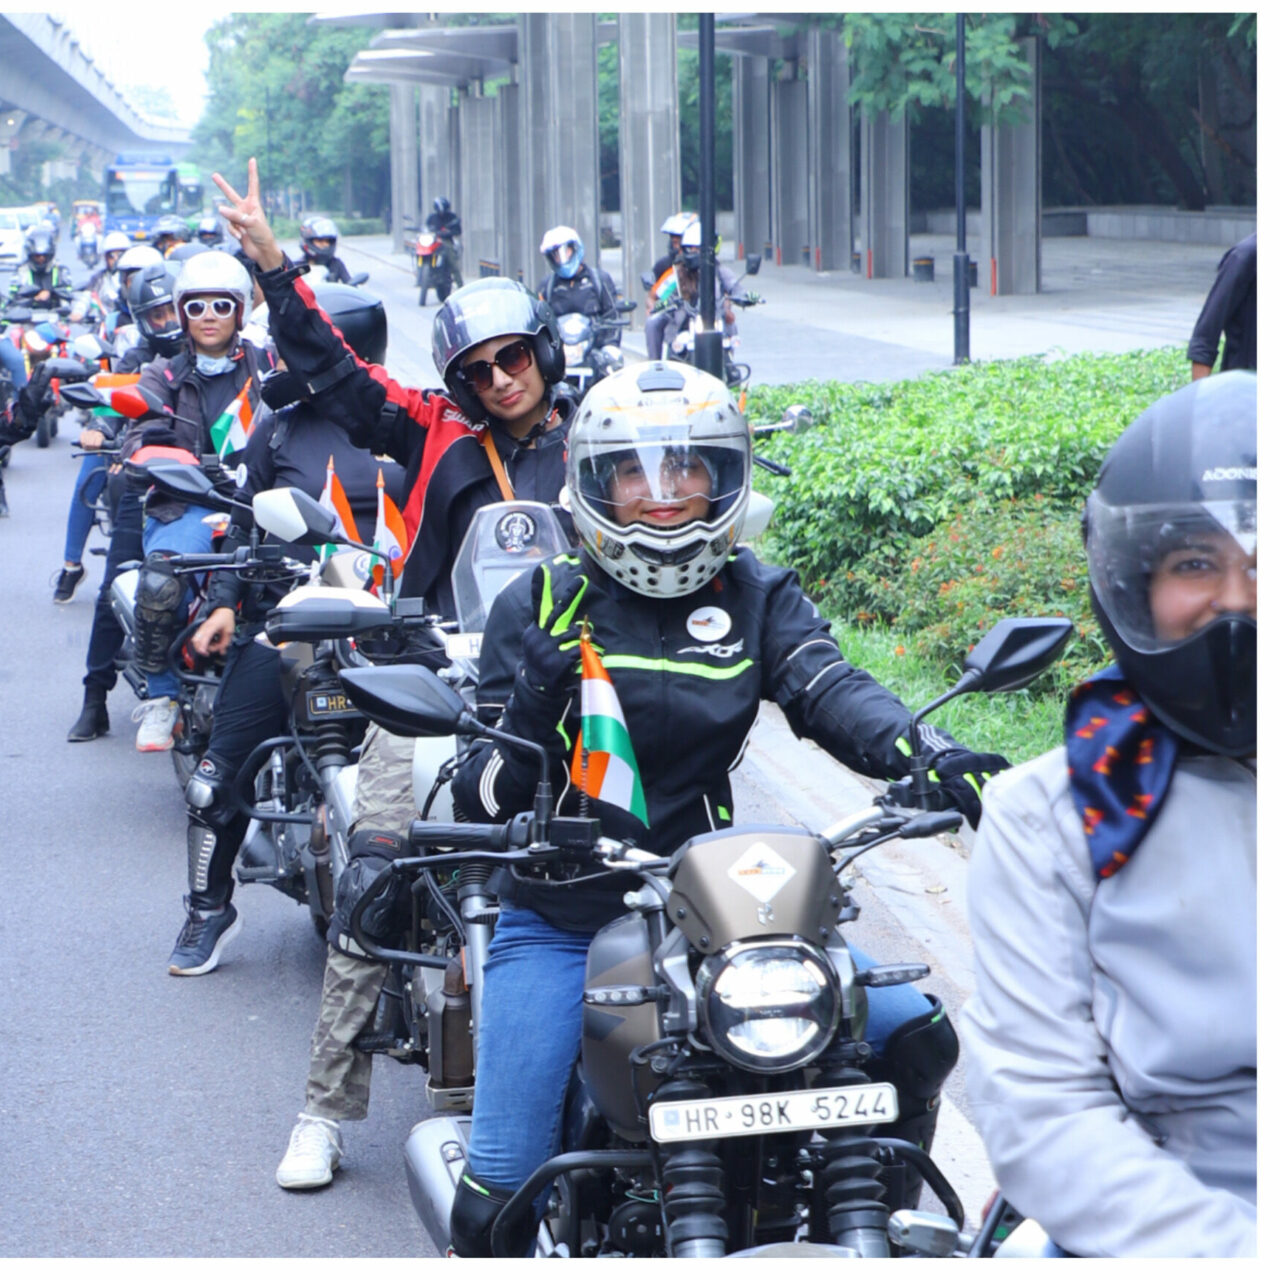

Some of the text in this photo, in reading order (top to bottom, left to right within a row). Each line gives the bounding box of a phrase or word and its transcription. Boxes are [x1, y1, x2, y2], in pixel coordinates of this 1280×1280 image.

[327, 695, 347, 711] HR
[686, 1092, 887, 1134] HR 98K 5244
